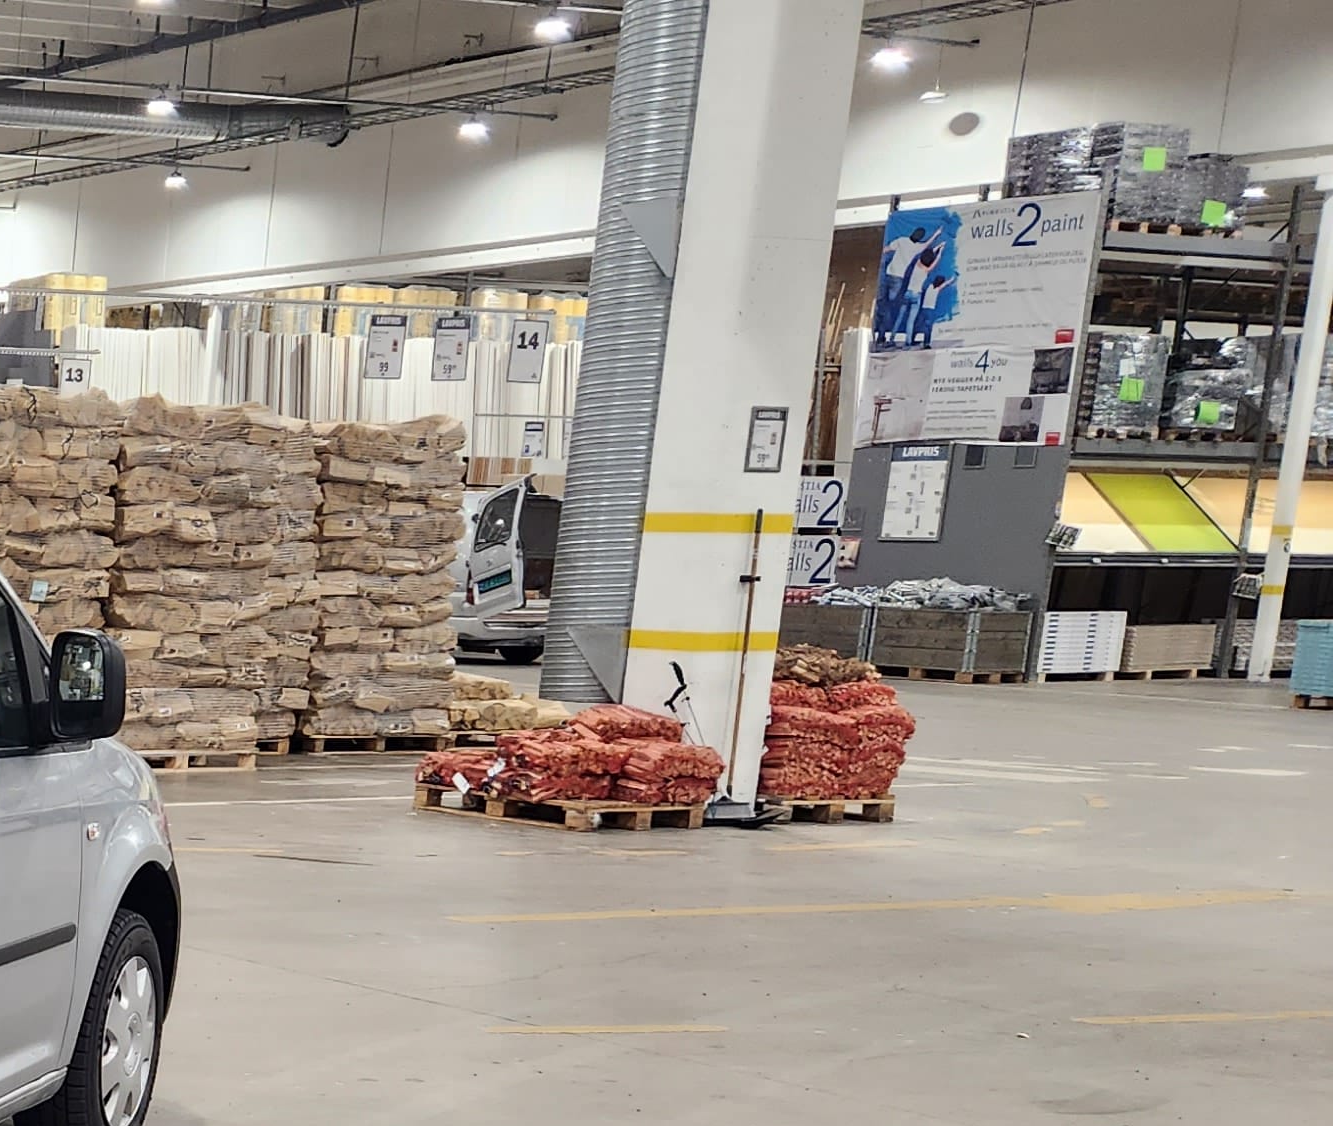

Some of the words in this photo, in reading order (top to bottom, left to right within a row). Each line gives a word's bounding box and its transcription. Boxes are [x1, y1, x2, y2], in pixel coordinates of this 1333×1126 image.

[971, 218, 1014, 239] walls
[1040, 214, 1084, 237] paint
[517, 331, 540, 350] 14
[65, 368, 83, 382] 13
[902, 445, 940, 457] LAVPRIS
[817, 480, 844, 526] 2
[808, 538, 836, 584] 2
